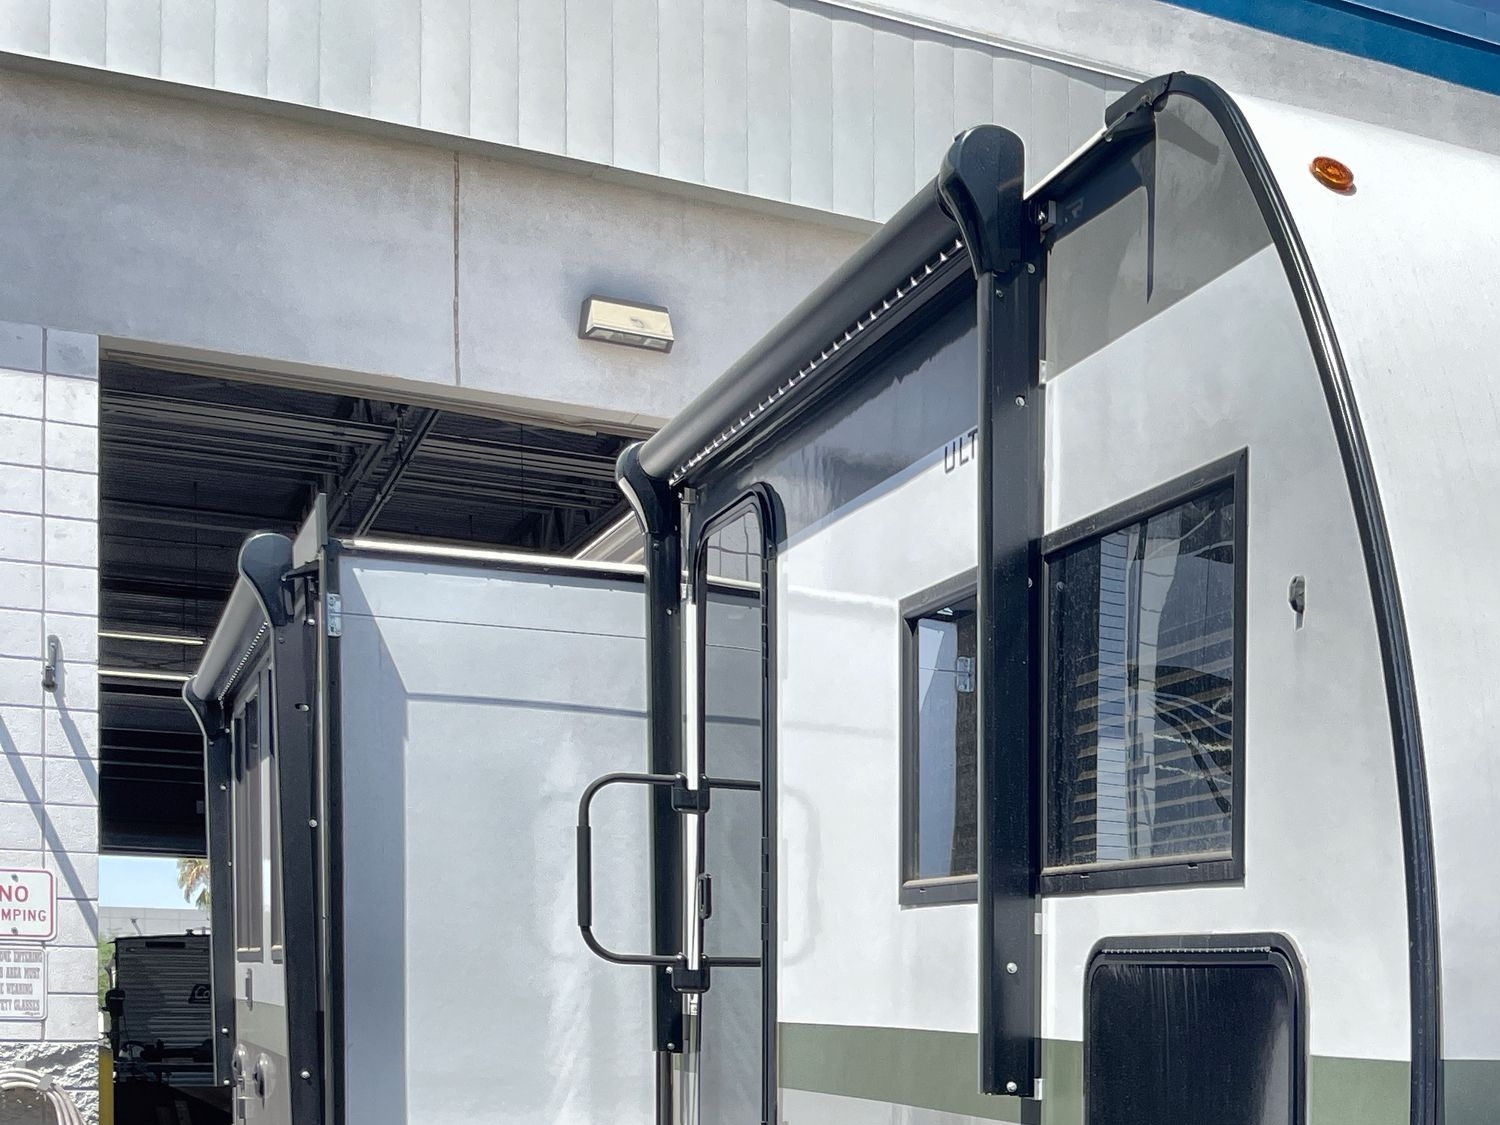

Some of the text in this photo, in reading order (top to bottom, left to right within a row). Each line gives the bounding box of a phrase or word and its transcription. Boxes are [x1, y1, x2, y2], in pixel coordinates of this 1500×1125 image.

[944, 428, 978, 474] ULT
[0, 885, 29, 902] NO
[1, 908, 47, 922] MPING
